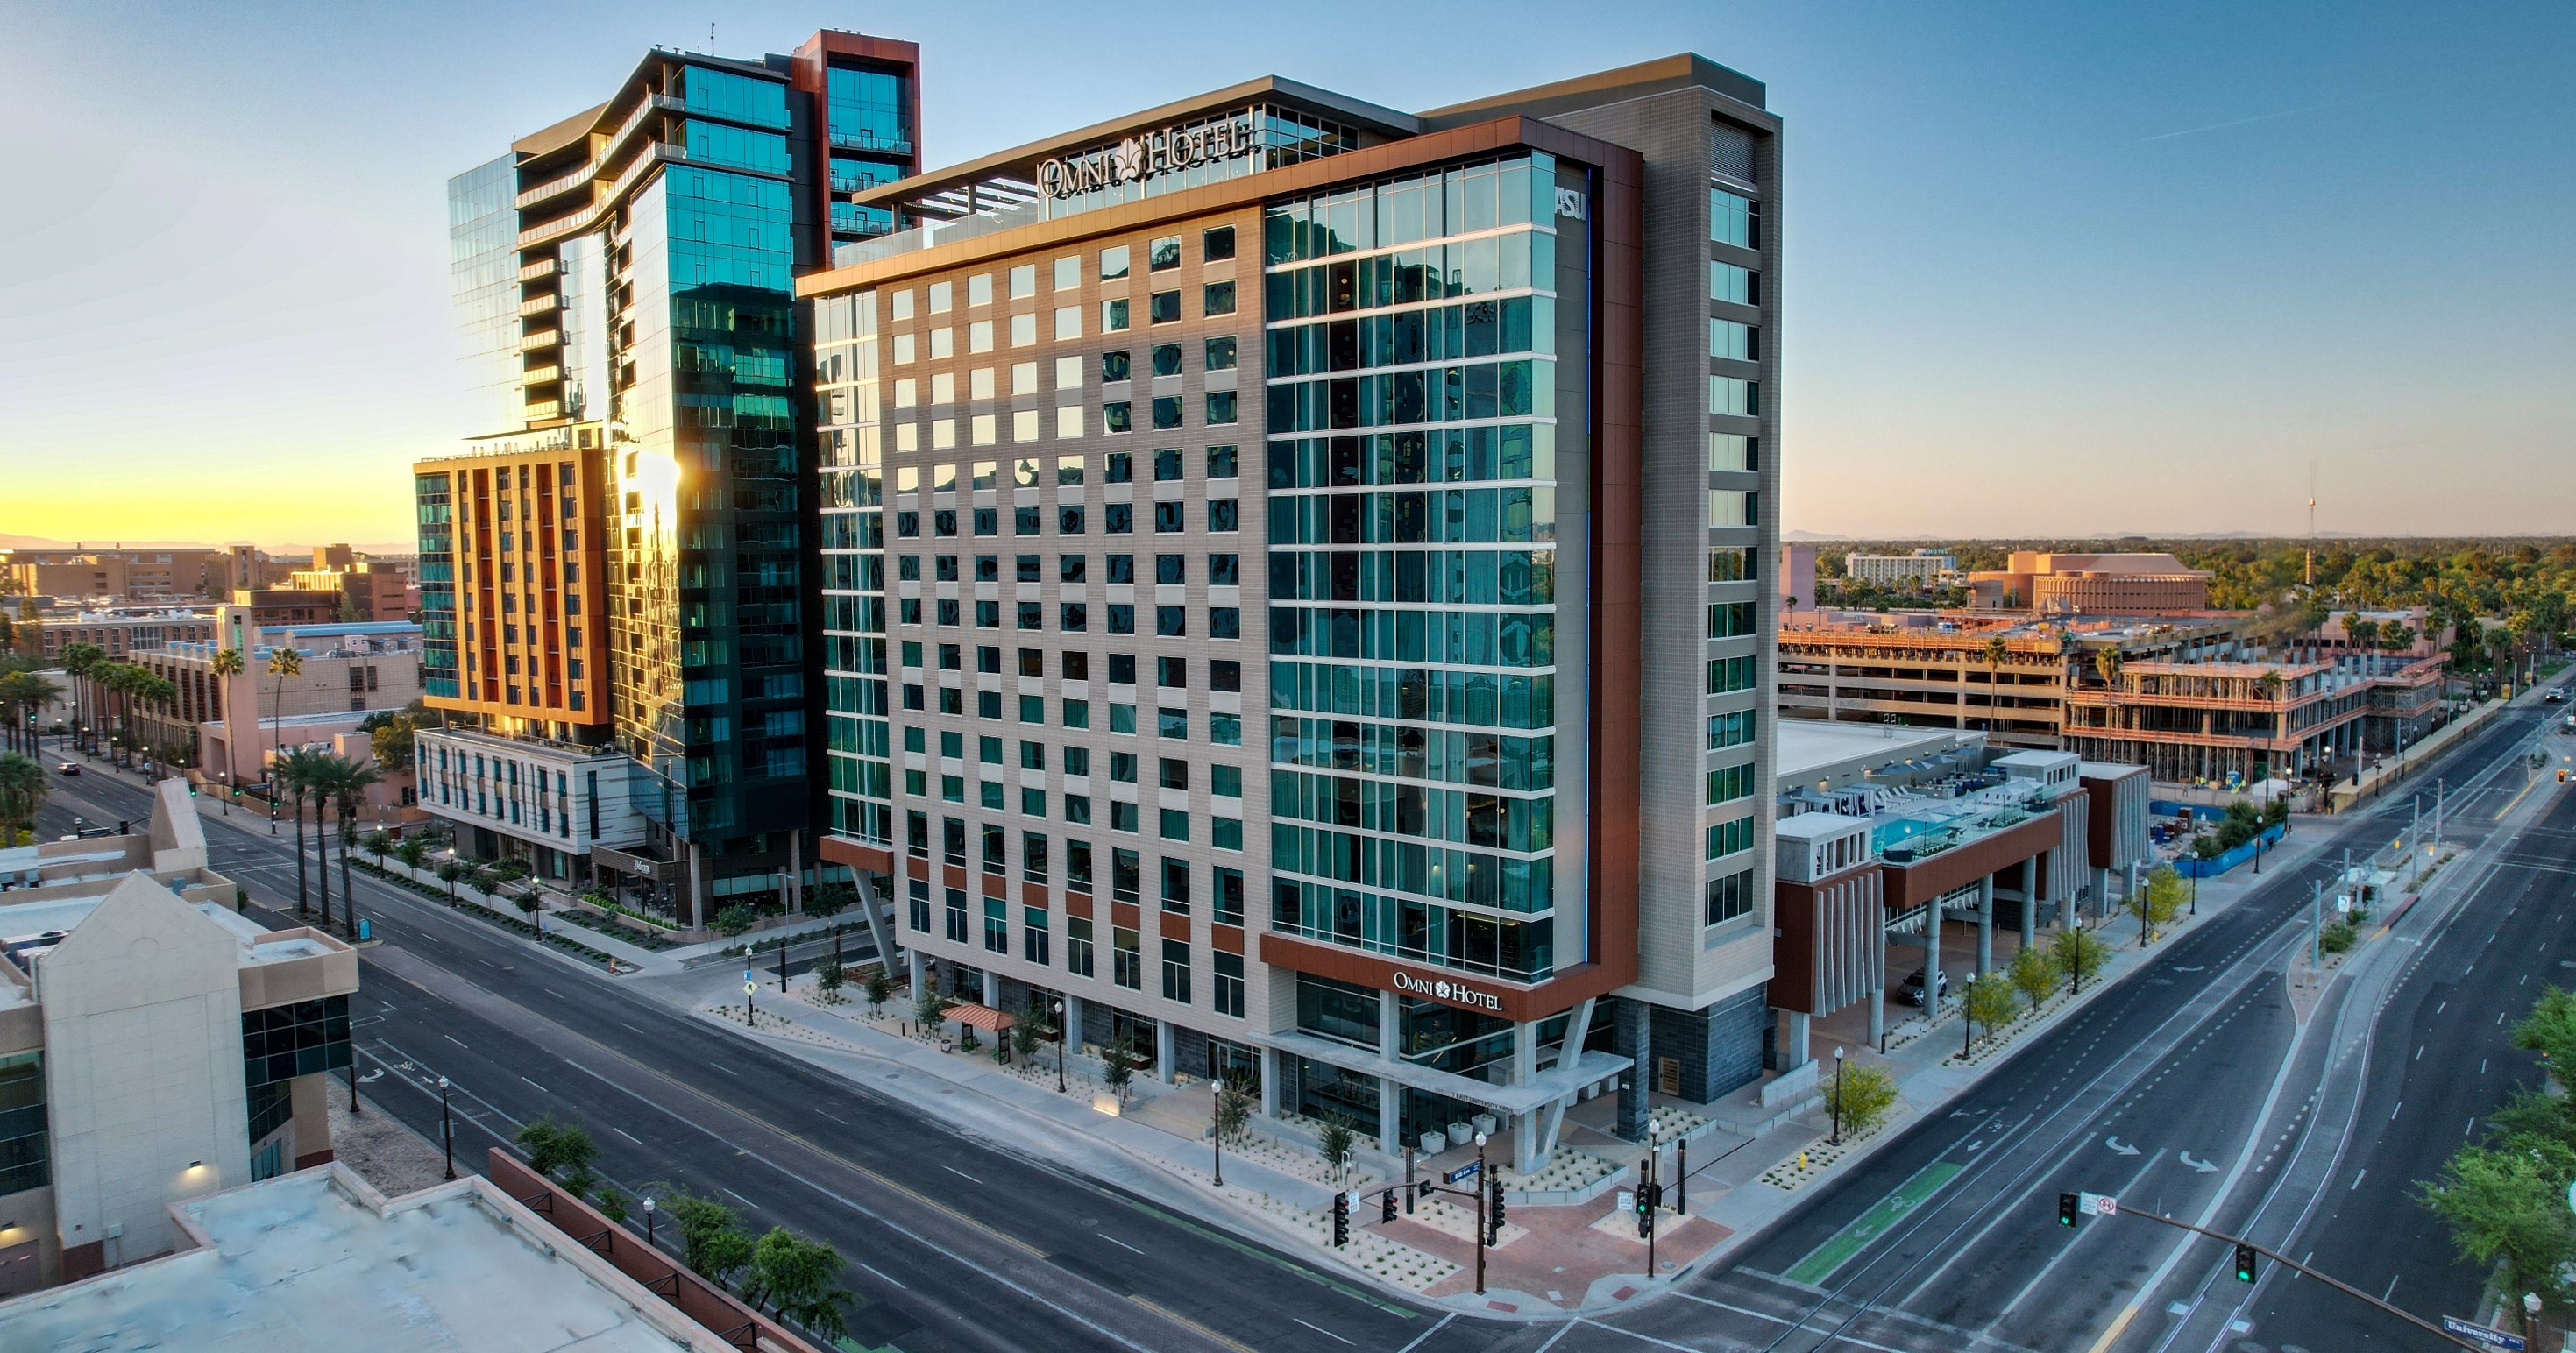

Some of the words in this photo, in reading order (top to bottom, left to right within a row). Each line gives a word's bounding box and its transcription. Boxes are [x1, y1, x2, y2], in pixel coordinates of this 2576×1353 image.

[1039, 153, 1111, 198] OMNI
[1146, 120, 1247, 174] HOTEL
[1554, 186, 1587, 221] ASU
[1394, 971, 1433, 996] OMNI
[1452, 983, 1503, 1011] HOTEL
[1456, 1093, 1469, 1102] EAST
[1469, 1097, 1499, 1110] UNIVERSITY
[2448, 1321, 2506, 1344] University
